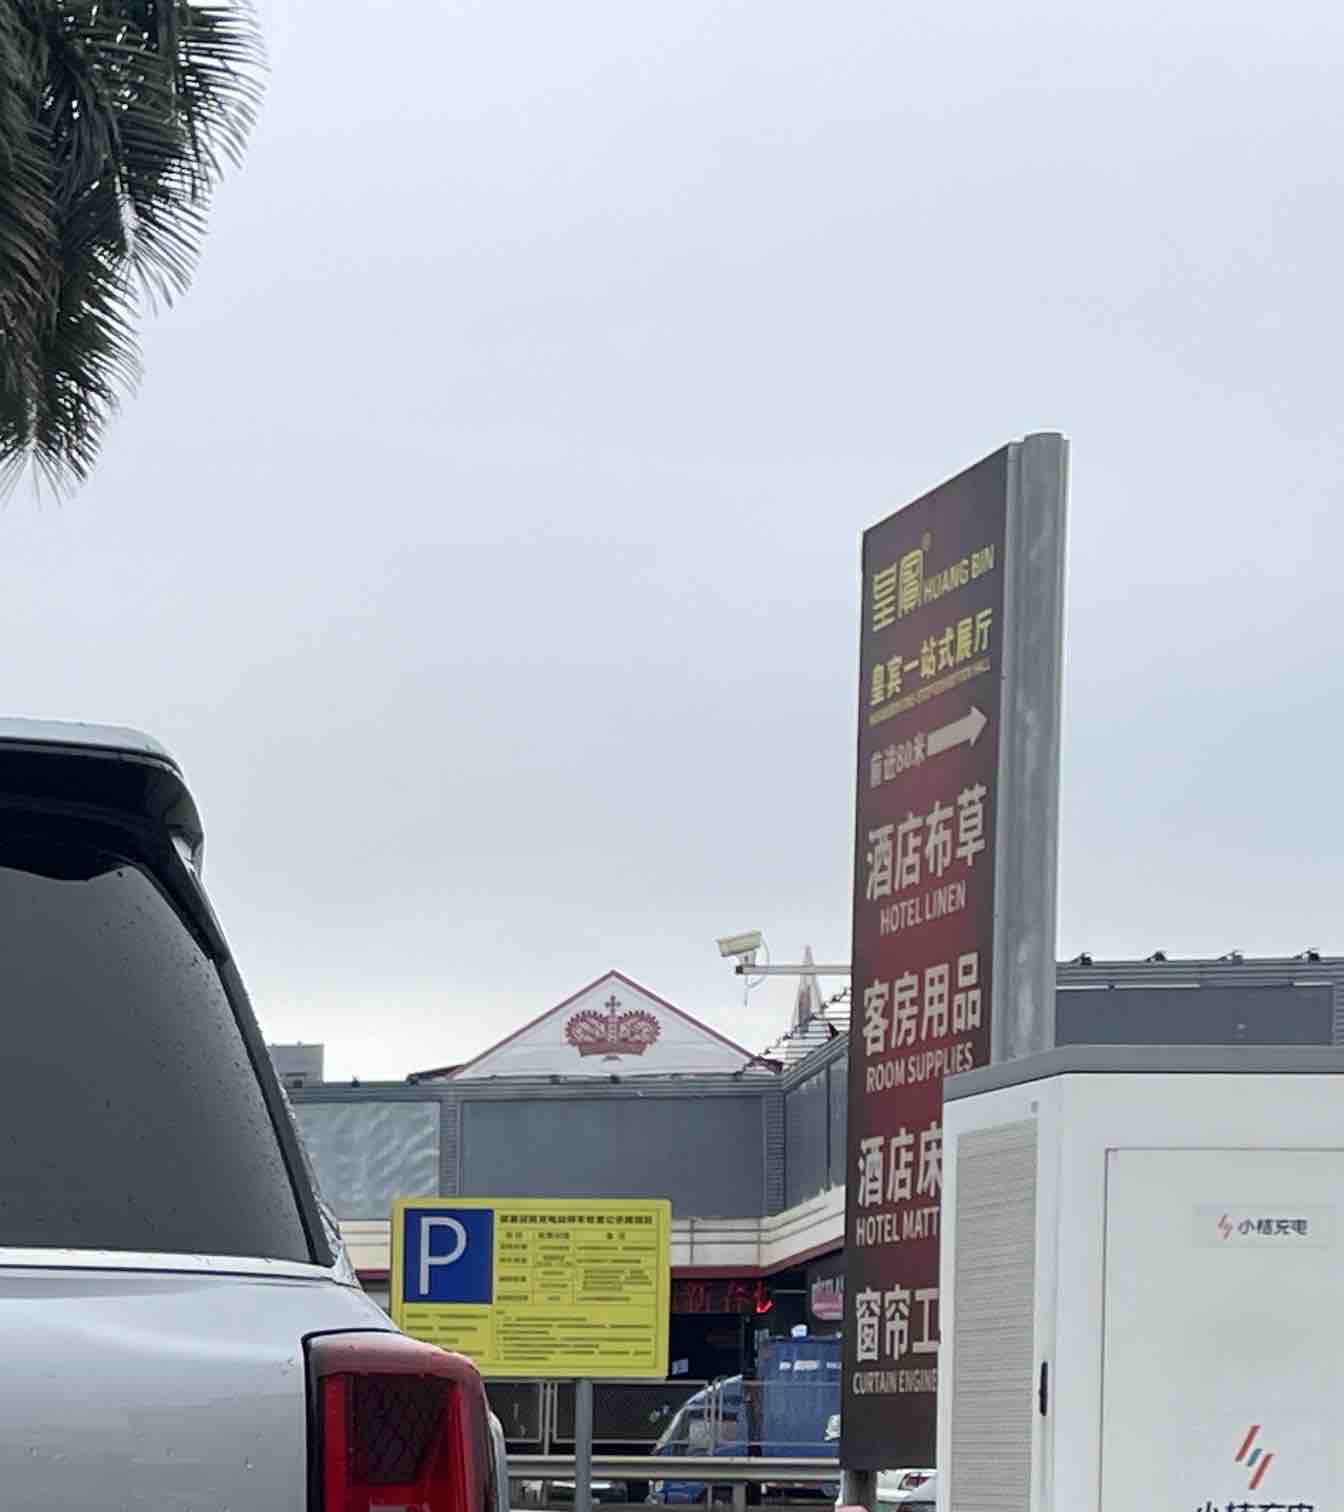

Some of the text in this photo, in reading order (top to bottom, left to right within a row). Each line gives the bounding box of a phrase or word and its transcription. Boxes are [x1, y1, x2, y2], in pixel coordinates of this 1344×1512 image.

[865, 783, 987, 900] 酒店布草
[880, 880, 967, 936] HOTEL LINEN
[862, 952, 982, 1056] 客房用品
[866, 1041, 974, 1093] ROOM SUPPLIES
[857, 1120, 943, 1208] 酒店床
[419, 1216, 467, 1296] P
[855, 1209, 901, 1248] HOTEL
[1237, 1216, 1308, 1238] 小桔充电
[855, 1283, 939, 1363] 窗帘工
[852, 1370, 897, 1396] CURTAIN
